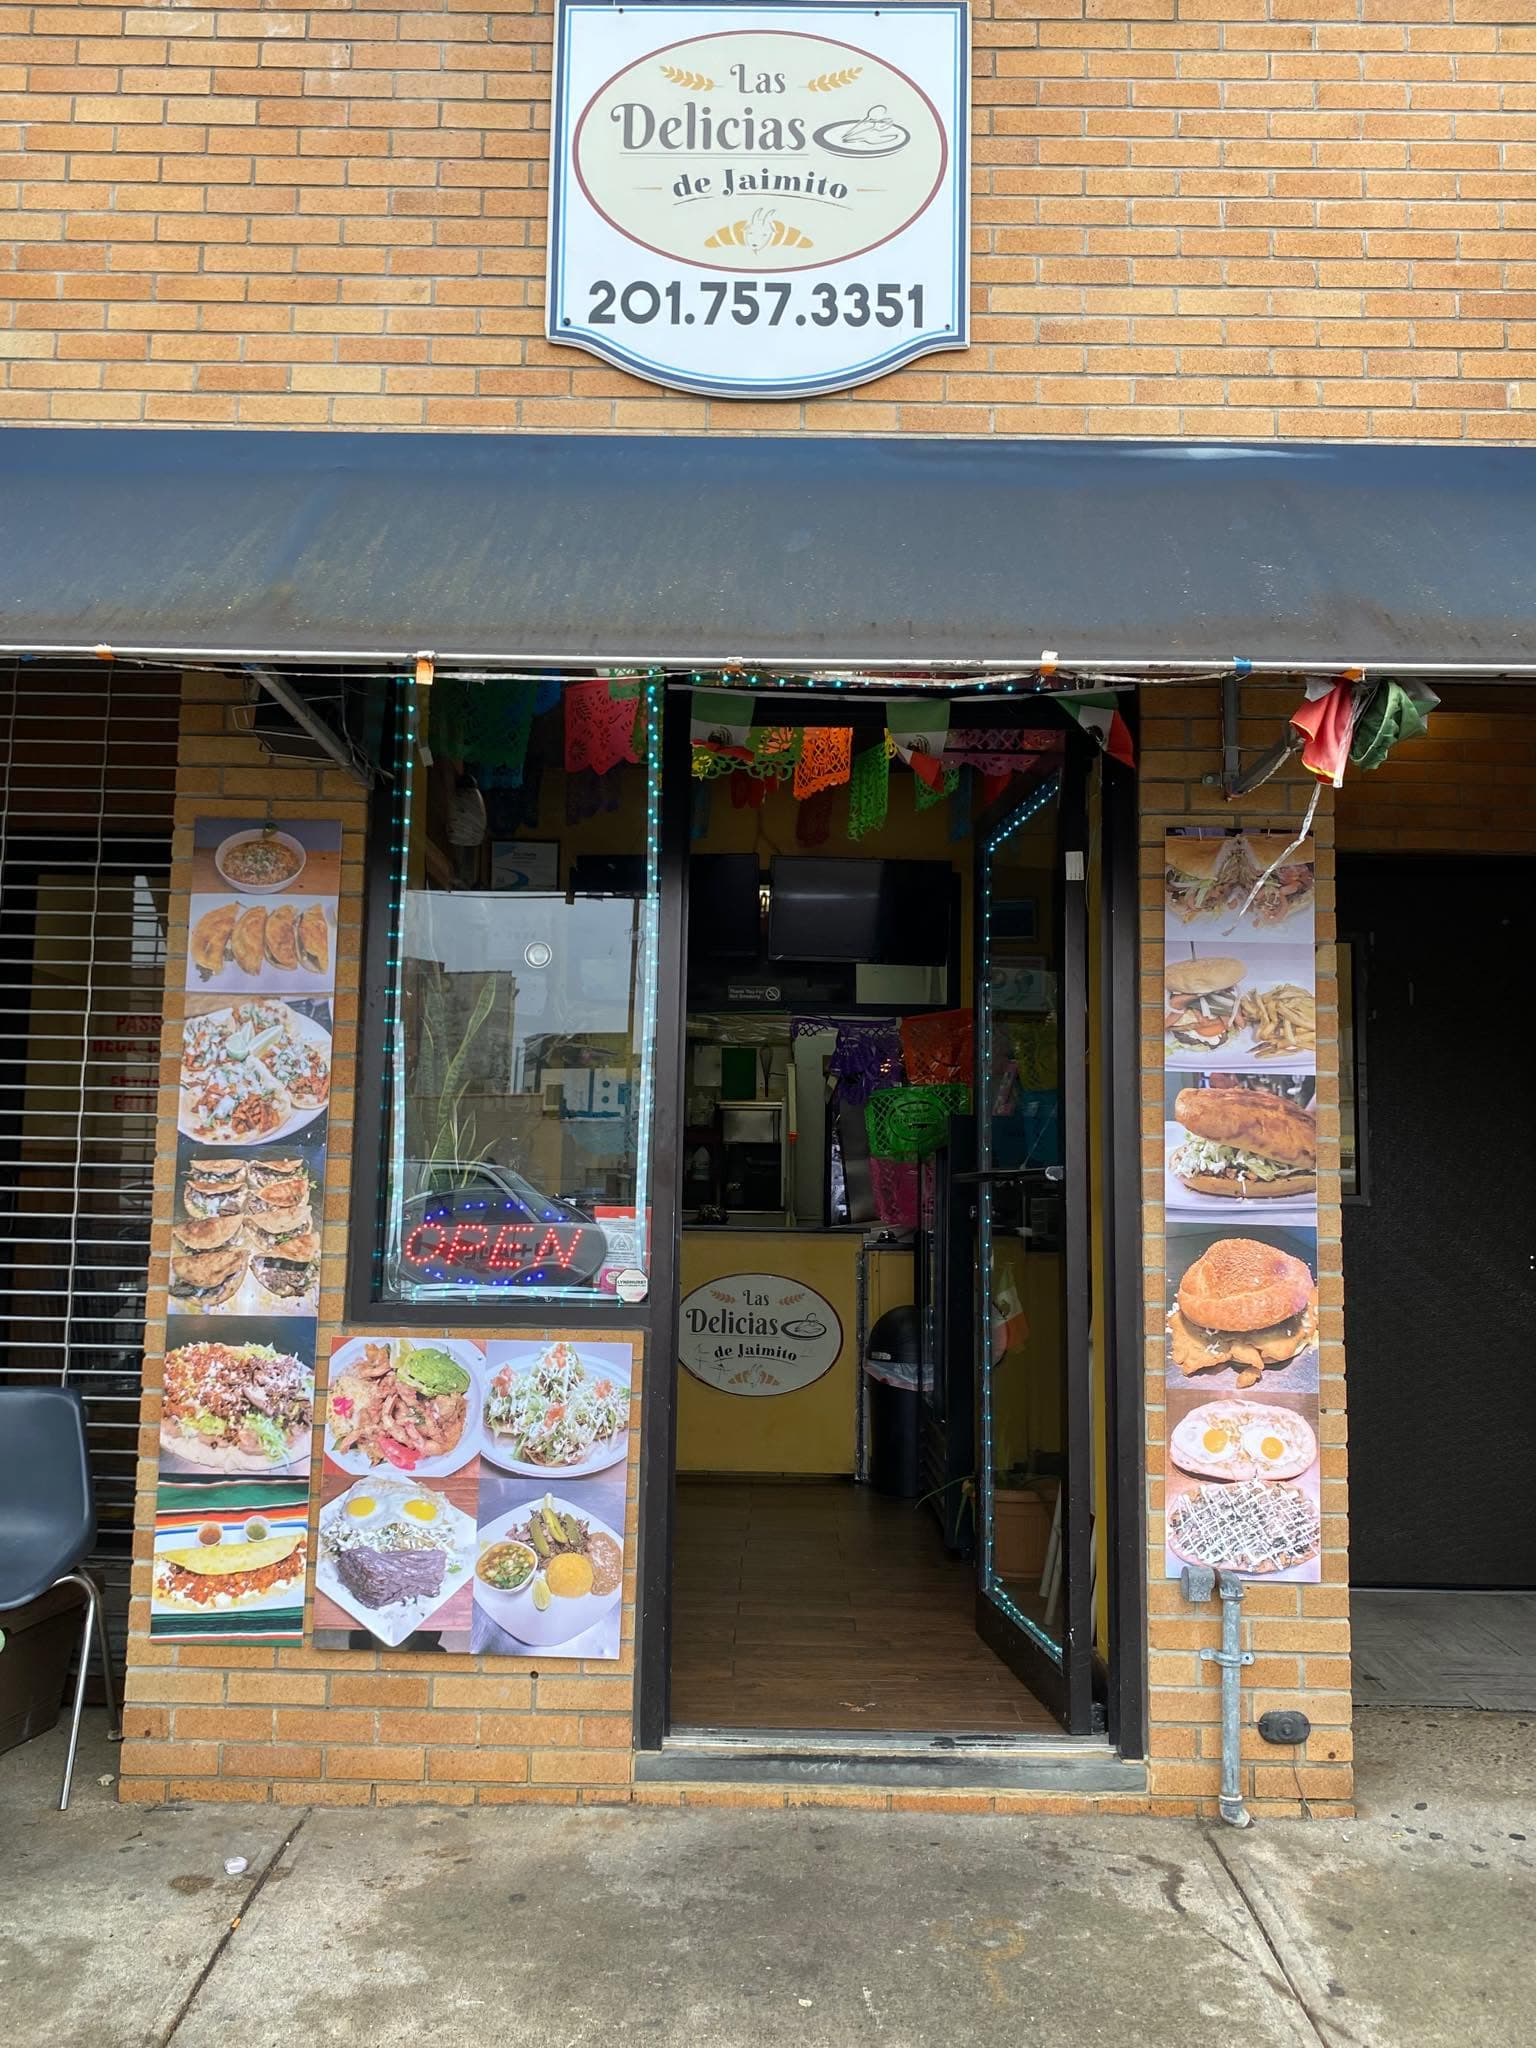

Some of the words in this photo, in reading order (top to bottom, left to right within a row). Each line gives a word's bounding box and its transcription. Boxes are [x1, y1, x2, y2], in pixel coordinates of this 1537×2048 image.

[730, 63, 786, 94] Las
[610, 101, 807, 151] Delicias
[673, 173, 712, 199] de
[722, 167, 848, 200] Jaimito
[588, 280, 924, 329] 201.757.3351
[404, 1222, 583, 1268] OPEN
[742, 1289, 770, 1306] Las
[685, 1308, 778, 1336] Delicias
[714, 1345, 733, 1359] de
[737, 1343, 798, 1361] Jaimito
